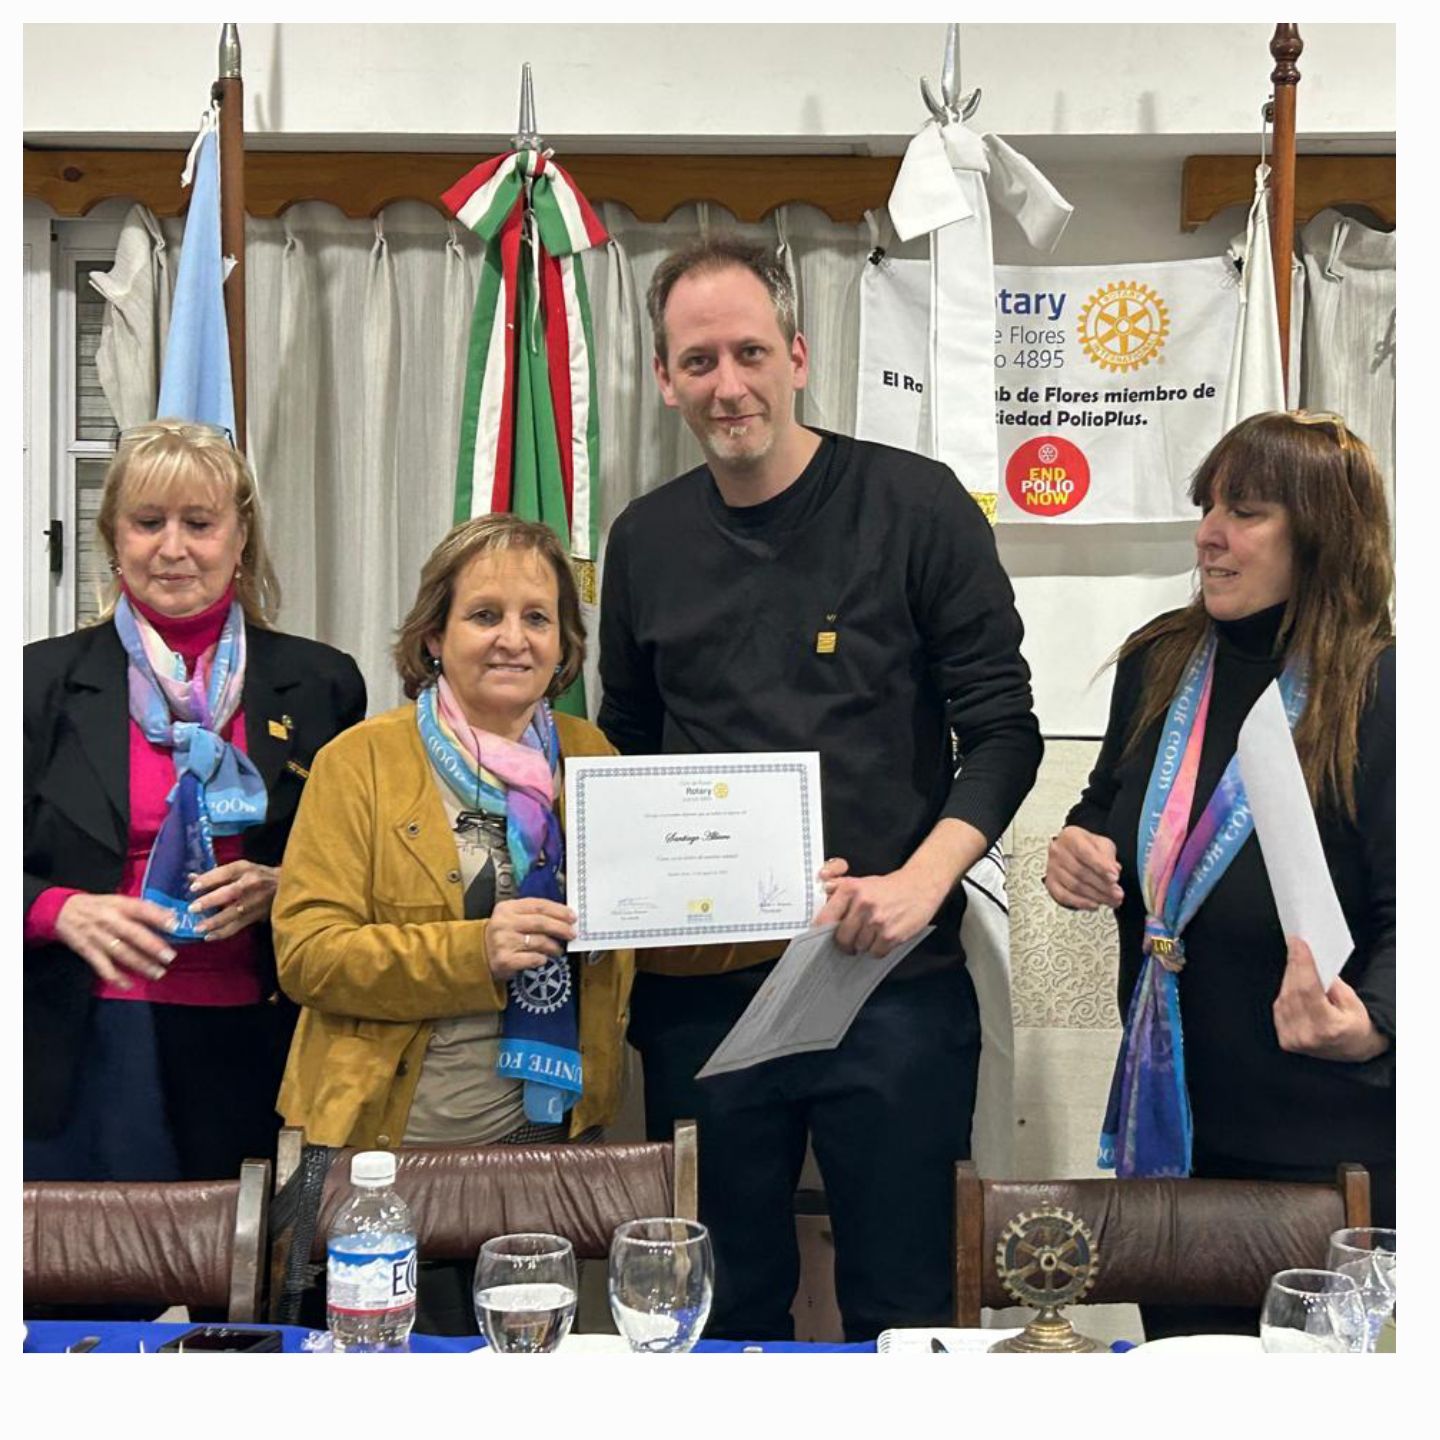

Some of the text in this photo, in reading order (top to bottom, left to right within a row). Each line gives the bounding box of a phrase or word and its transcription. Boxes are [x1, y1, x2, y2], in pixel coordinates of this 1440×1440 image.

[995, 288, 1067, 322] tary
[994, 325, 1066, 345] e Flores
[1012, 349, 1065, 370] 4895
[882, 370, 900, 387] El
[1016, 386, 1040, 403] de
[1045, 386, 1100, 404] Flores
[1103, 385, 1188, 404] miembro
[1193, 382, 1216, 400] de
[995, 409, 1148, 427] iedad PolioPlus.
[1028, 467, 1066, 481] END
[1020, 479, 1075, 495] POLIO
[1025, 491, 1069, 507] NOW
[686, 786, 712, 797] Rotary
[497, 1051, 583, 1085] UNITE FO
